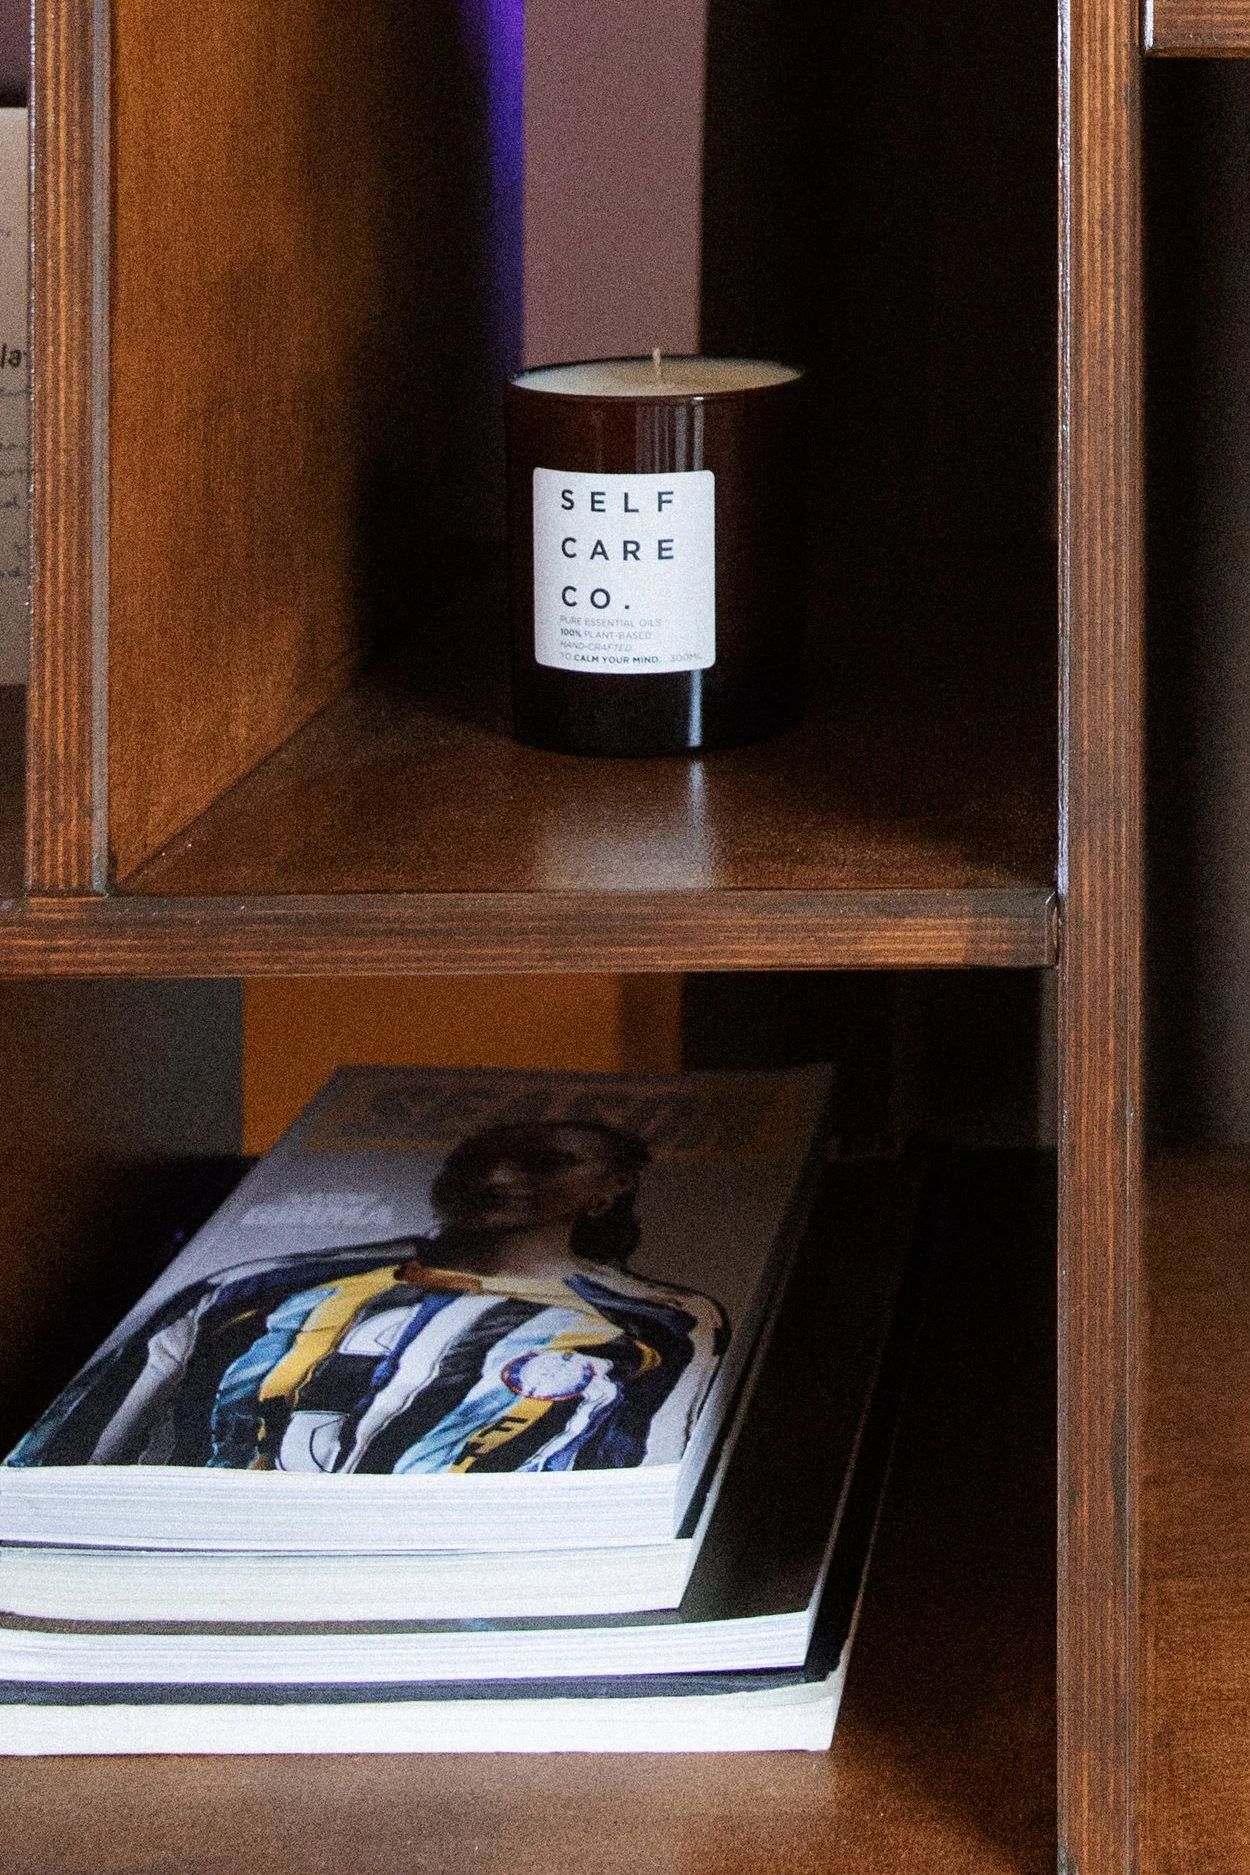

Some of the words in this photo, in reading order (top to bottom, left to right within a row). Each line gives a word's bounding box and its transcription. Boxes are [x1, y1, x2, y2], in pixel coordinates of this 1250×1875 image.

[560, 489, 675, 513] SELF
[560, 536, 676, 561] CARE
[560, 585, 631, 610] CO.
[584, 617, 635, 627] ESSENTIAL
[560, 628, 582, 638] 100%
[573, 653, 600, 663] CALM
[602, 655, 630, 664] YOUR
[632, 656, 662, 665] MIND.
